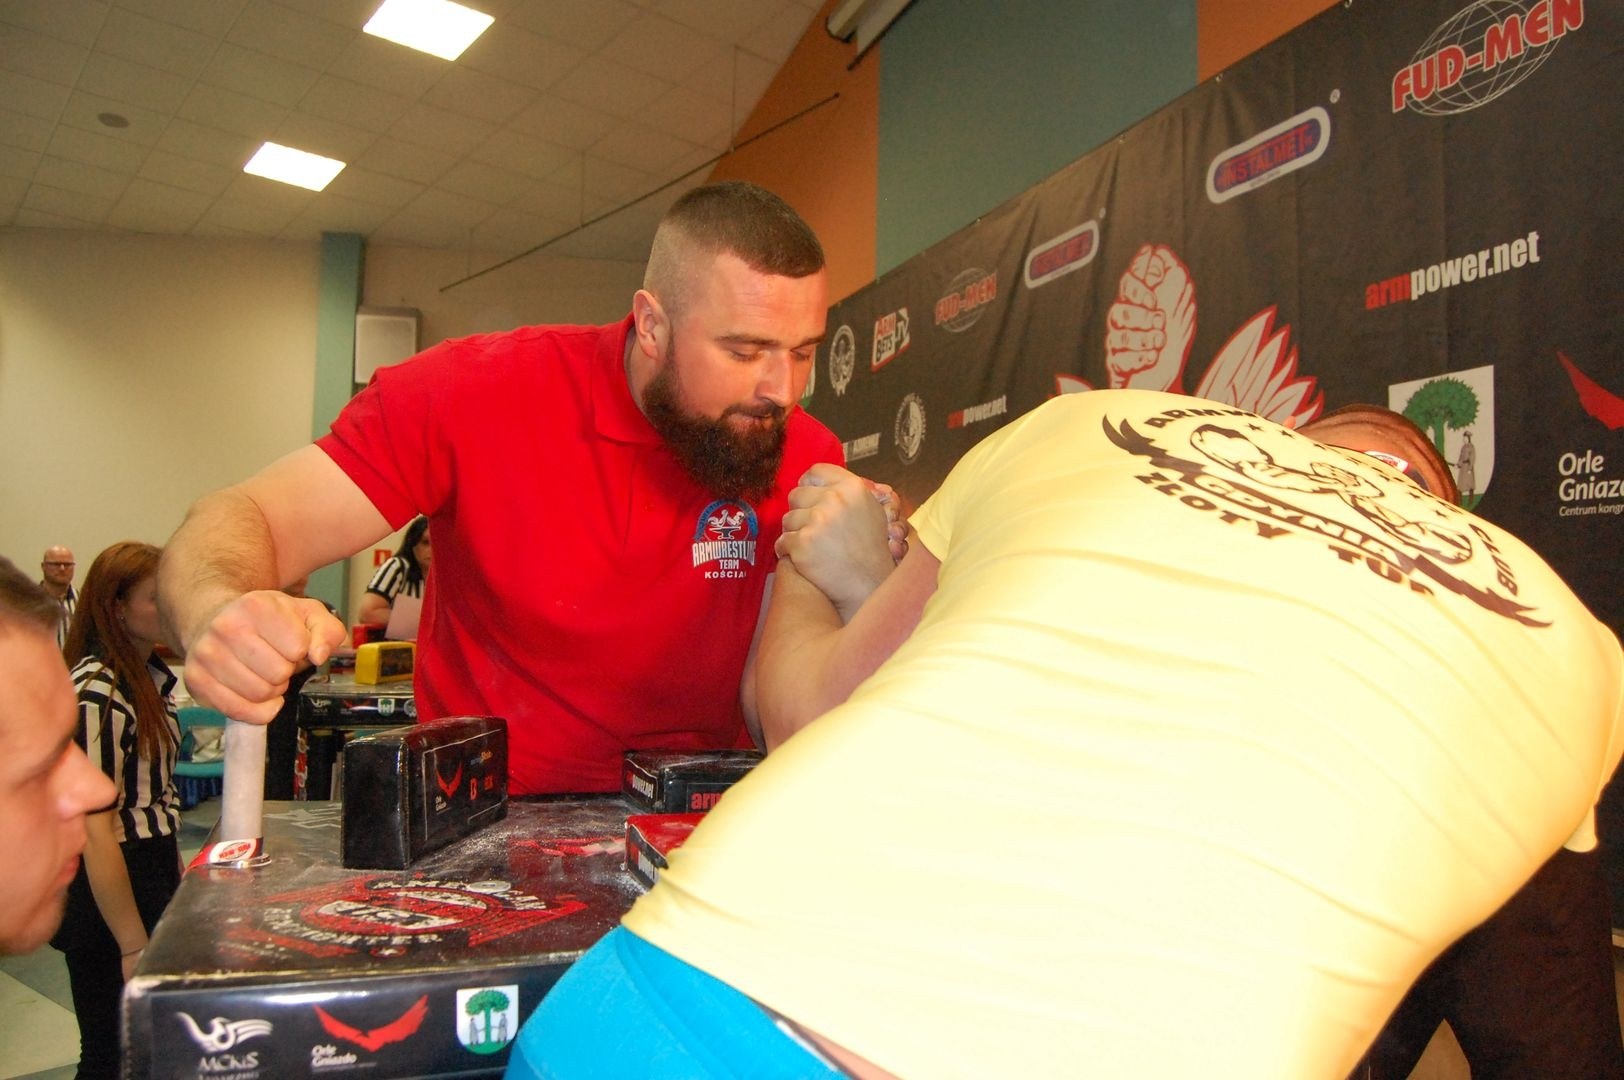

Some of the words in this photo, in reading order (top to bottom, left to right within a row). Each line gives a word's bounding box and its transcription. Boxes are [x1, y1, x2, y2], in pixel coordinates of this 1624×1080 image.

[1392, 0, 1584, 113] FUD-MEN
[1365, 230, 1541, 311] armpower.net
[1558, 449, 1605, 476] Orle
[1559, 505, 1597, 517] Centrum
[719, 559, 740, 570] TEAM
[704, 570, 747, 579] KOŚCIA
